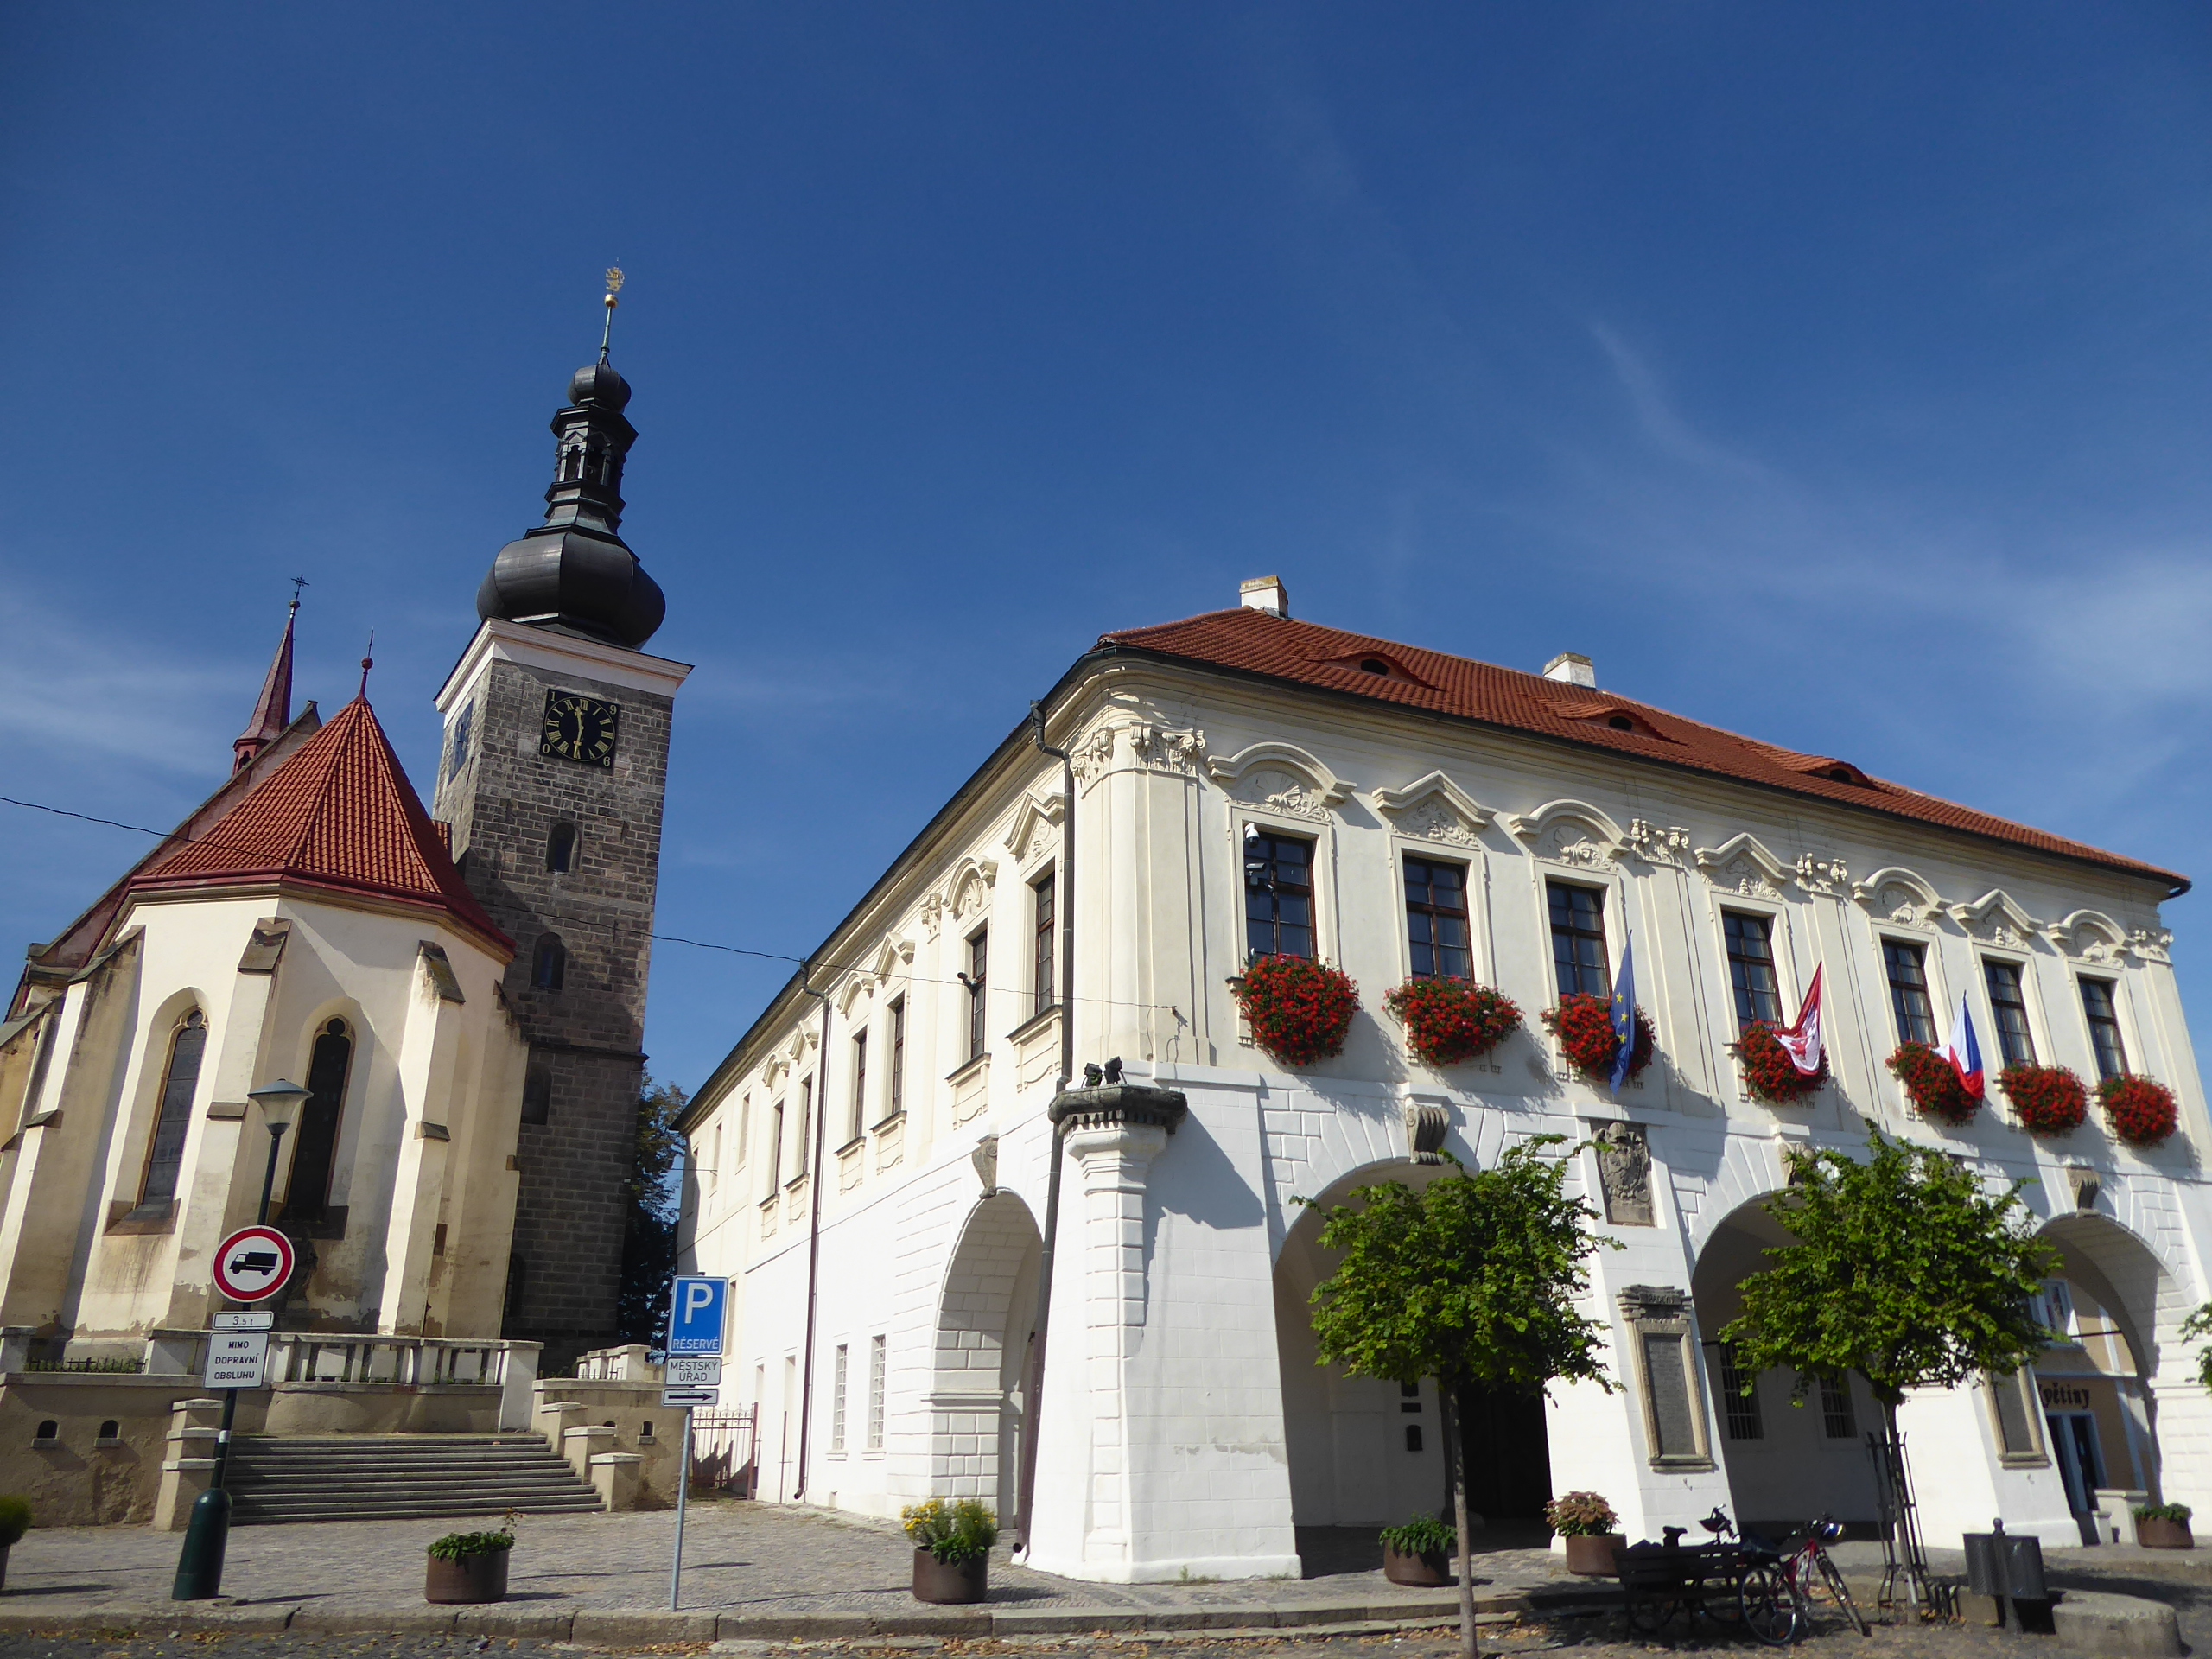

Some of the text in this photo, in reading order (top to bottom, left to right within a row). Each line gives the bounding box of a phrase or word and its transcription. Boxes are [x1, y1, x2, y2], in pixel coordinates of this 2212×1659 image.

[609, 704, 617, 715] 9
[603, 756, 611, 766] 6
[684, 1282, 714, 1324] P
[228, 1340, 250, 1349] MIMO
[672, 1336, 719, 1350] RÉSERVÉ
[214, 1352, 260, 1364] DOPRAVNÍ
[670, 1359, 719, 1370] MĚSTSKÝ
[213, 1370, 255, 1380] OBSLUHU
[679, 1370, 708, 1382] ÚŘAD
